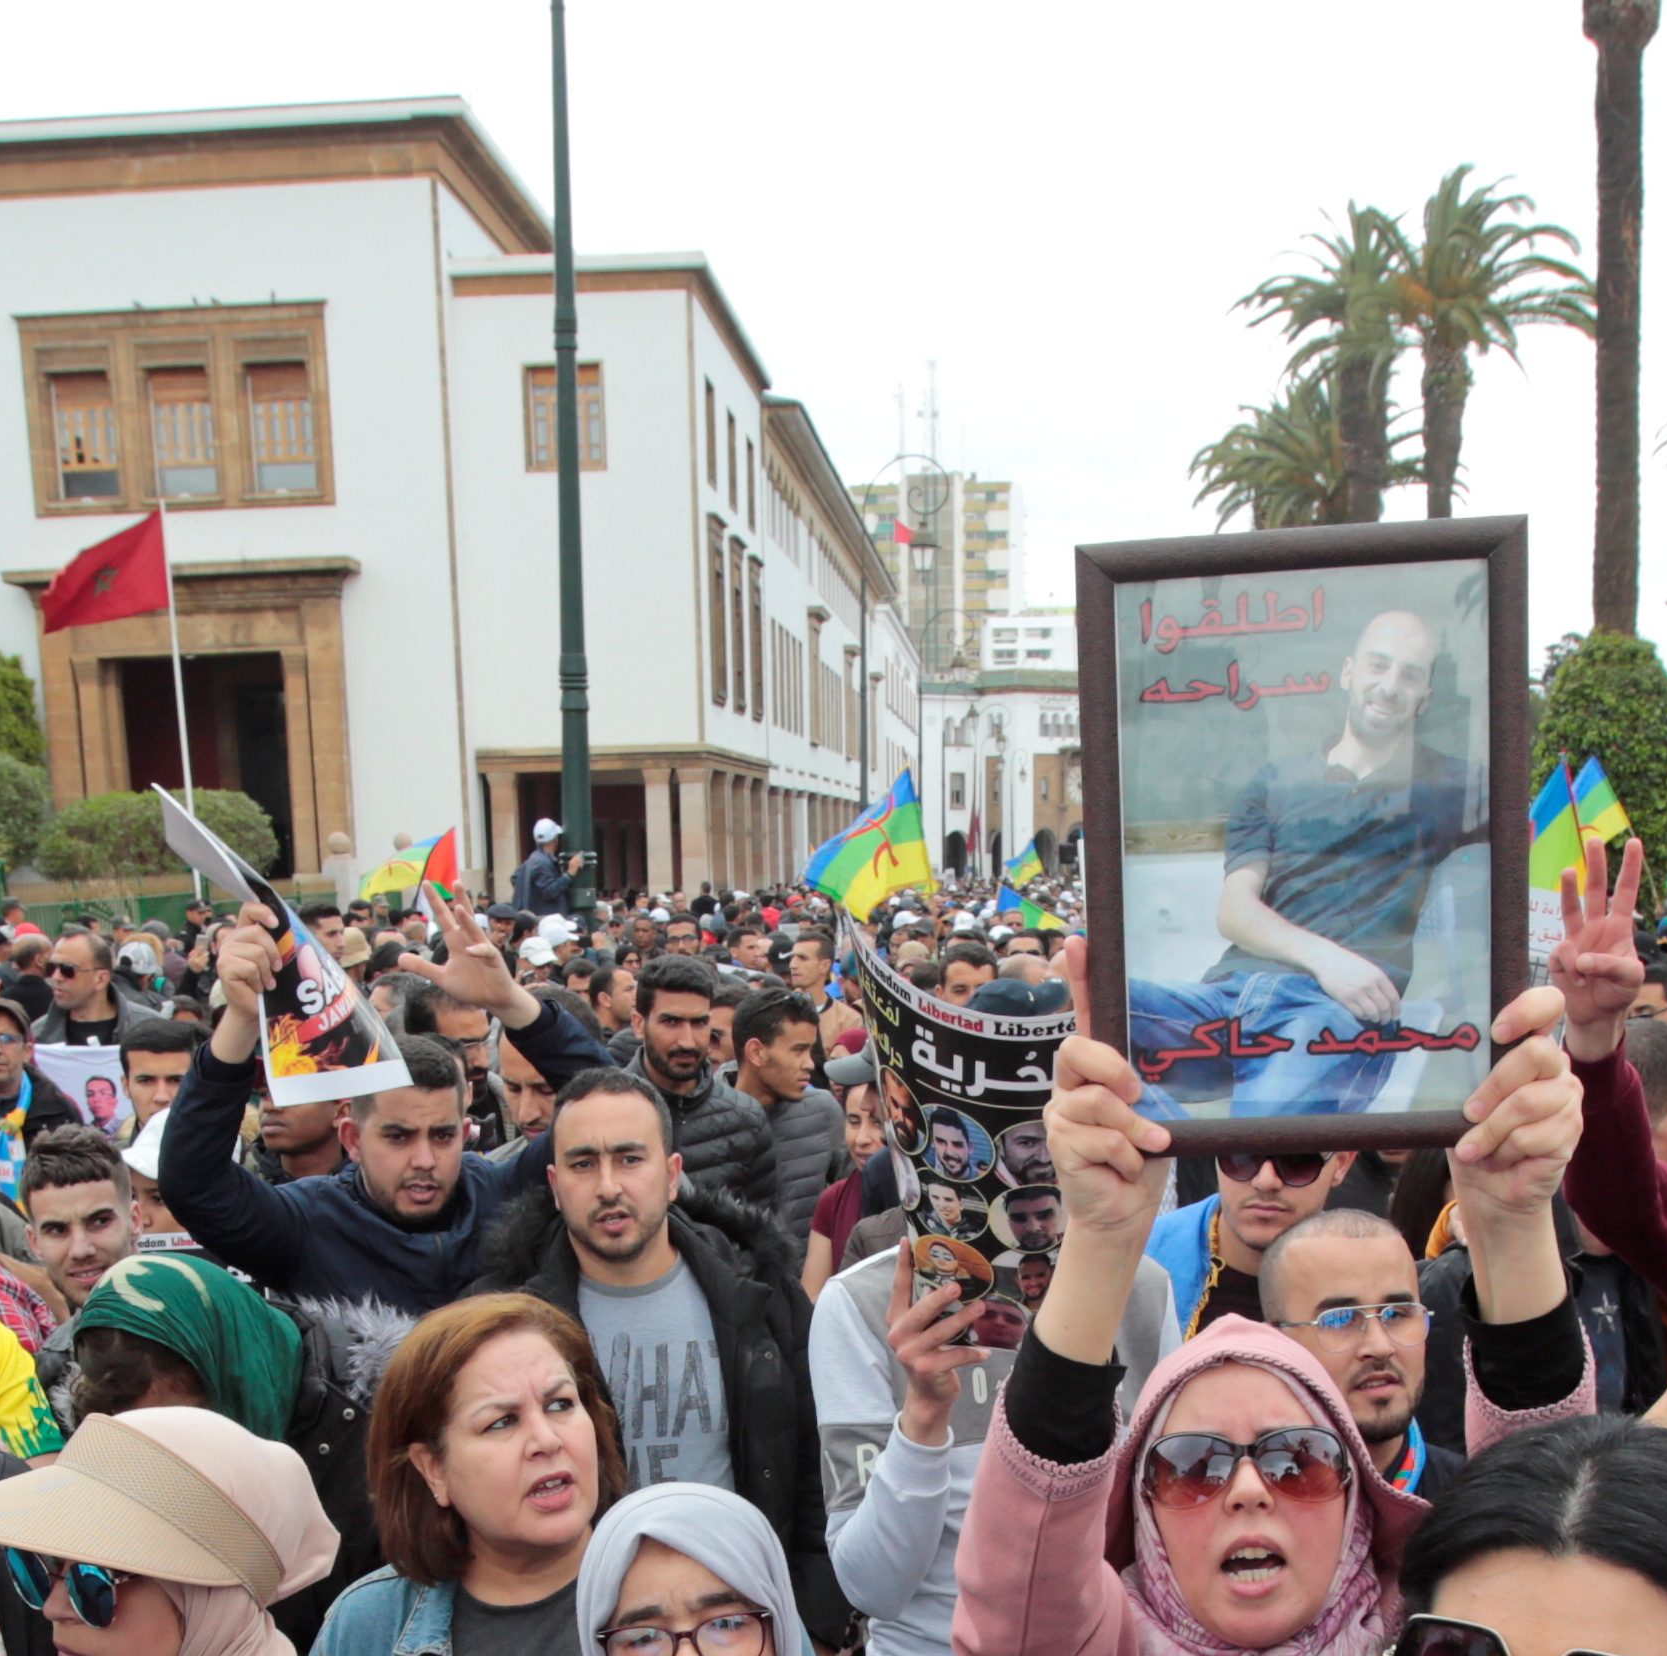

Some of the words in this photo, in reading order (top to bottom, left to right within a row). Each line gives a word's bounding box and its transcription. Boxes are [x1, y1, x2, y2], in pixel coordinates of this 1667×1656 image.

[1138, 582, 1326, 656] اطلقوا
[865, 948, 912, 1003] Freedom
[917, 996, 984, 1033] Libertad
[994, 1016, 1076, 1037] Liberté
[1306, 1019, 1481, 1059] محمد
